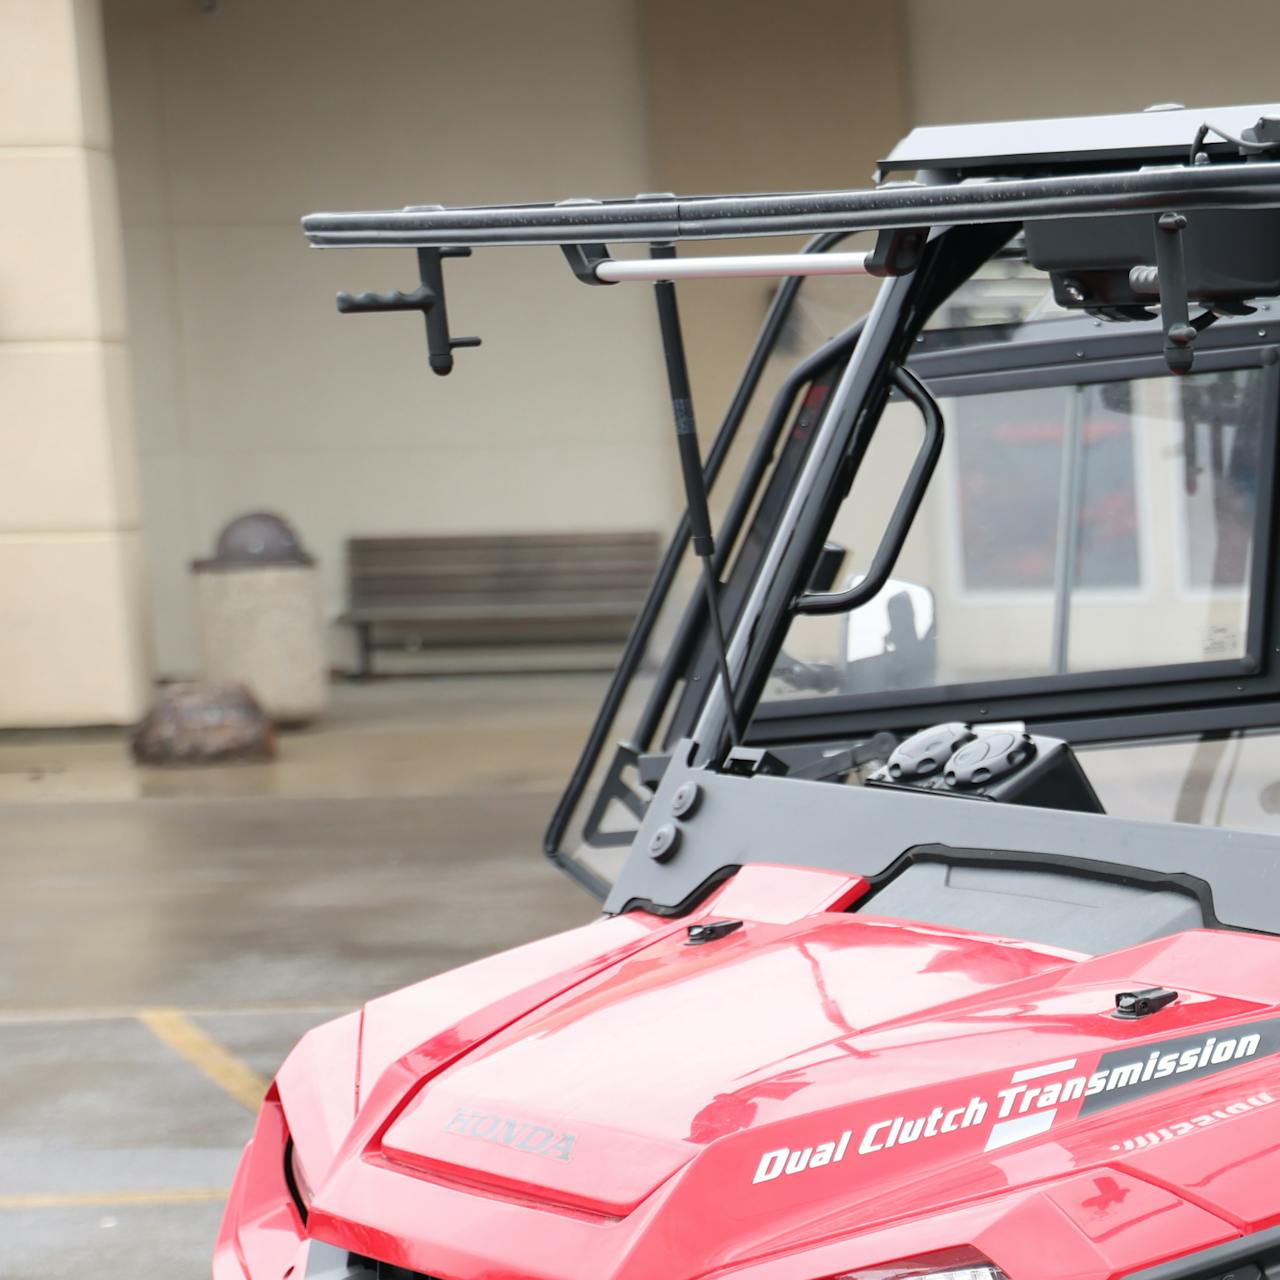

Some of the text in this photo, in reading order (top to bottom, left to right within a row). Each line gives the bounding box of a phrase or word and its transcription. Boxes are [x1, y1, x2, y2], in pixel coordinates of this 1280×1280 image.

[446, 1107, 576, 1162] HONDA
[752, 1031, 1262, 1184] Dual Clutch Transmission
